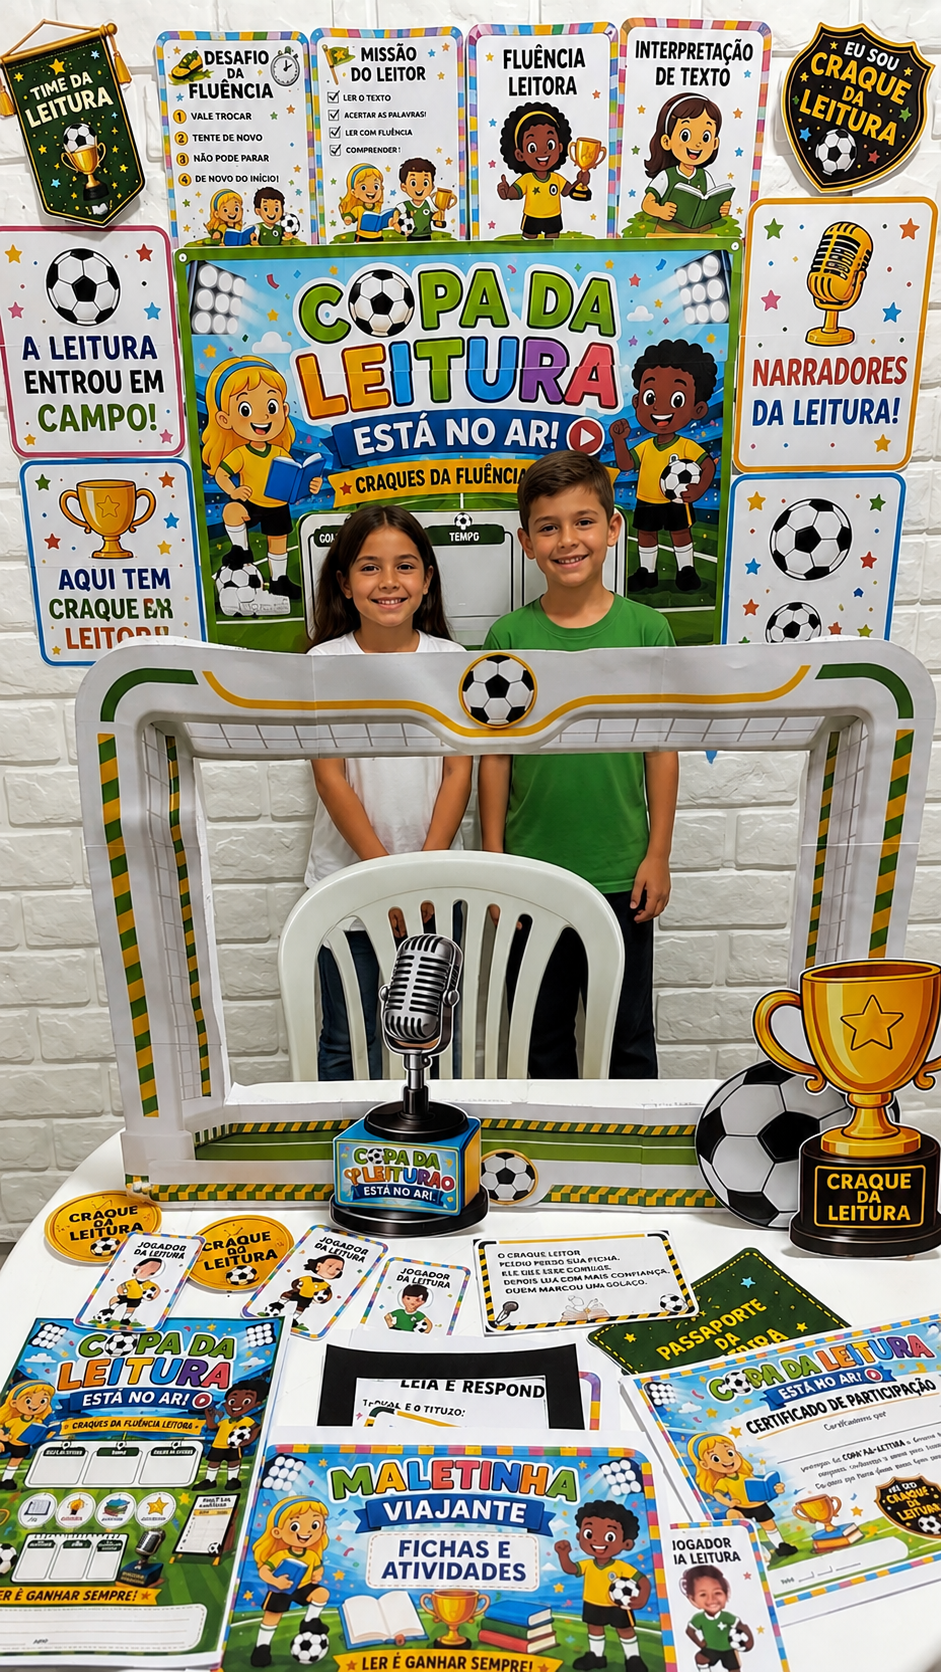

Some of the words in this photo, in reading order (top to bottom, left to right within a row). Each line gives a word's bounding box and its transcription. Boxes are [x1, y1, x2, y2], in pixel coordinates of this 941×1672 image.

[204, 50, 269, 66] DESAFIO
[361, 43, 417, 62] MISSÃO
[503, 44, 586, 70] FLUÊNCIA
[635, 39, 753, 65] INTERPRETAÇÃO
[844, 41, 864, 58] EU
[866, 48, 900, 71] SOU
[227, 68, 244, 79] DA
[351, 67, 372, 82] DO
[377, 65, 426, 82] LEITOR
[656, 67, 675, 86] DE
[680, 67, 731, 87] TEXTO
[810, 52, 913, 105] CRAQUE
[30, 77, 68, 101] TIME
[70, 71, 93, 87] DA
[188, 80, 273, 99] FLUÊNCIA
[508, 75, 578, 96] LEITORA
[842, 86, 864, 106] DA
[25, 86, 114, 128] LEITURA
[343, 94, 357, 102] LER
[358, 94, 365, 102] O
[366, 94, 391, 102] TEXTO
[799, 89, 898, 146] LEITURA
[192, 134, 220, 142] TENTE
[222, 134, 235, 142] DE
[236, 134, 263, 142] NOVO
[193, 152, 213, 162] NÃO
[215, 154, 239, 162] PODE
[240, 154, 269, 162] PARAR
[250, 174, 279, 183] INÍCIO!
[299, 268, 510, 344] COPA
[527, 271, 618, 337] DA
[22, 336, 40, 360] A
[49, 335, 158, 361] LEITURA
[24, 369, 122, 394] ENTROU
[130, 369, 165, 393] EM
[295, 336, 618, 421] LEITURA
[752, 356, 908, 386] NARRADORES
[37, 403, 158, 432] CAMPO!
[752, 399, 784, 426] DA
[793, 398, 900, 425] LEITURA!
[353, 412, 436, 455] ESTÁ
[446, 417, 496, 445] NO
[504, 421, 560, 449] AR!
[355, 468, 425, 494] CRAQUES
[430, 468, 451, 485] DA
[59, 568, 115, 592] AQUI
[122, 568, 171, 590] TEM
[49, 598, 139, 622] CRAQUE
[354, 1148, 410, 1166] COPA
[413, 1151, 440, 1170] DA
[364, 1184, 391, 1196] ESTÁ
[393, 1186, 410, 1196] NO
[827, 1173, 912, 1191] CRAQUE
[857, 1190, 881, 1203] DA
[828, 1205, 911, 1221] LEITURA
[69, 1222, 143, 1241] LEITURA
[202, 1231, 271, 1252] CRAQUE
[314, 1243, 328, 1254] DA
[328, 1246, 366, 1263] LEITURA
[319, 1236, 369, 1256] JOGADOR
[204, 1249, 278, 1270] LEITURA
[396, 1274, 410, 1283] DA
[412, 1277, 451, 1289] LEITURA
[400, 1267, 450, 1281] JOGADOR
[656, 1298, 767, 1361] PASSAPORTE
[77, 1331, 183, 1358] COPA
[188, 1334, 235, 1360] DA
[714, 1332, 741, 1350] DA
[780, 1356, 822, 1380] DA
[816, 1334, 935, 1371] LEITURA
[56, 1357, 231, 1391] LEITURA
[82, 1387, 124, 1406] ESTÁ
[128, 1392, 155, 1404] NO
[158, 1392, 189, 1406] AR!
[400, 1380, 439, 1390] LEIA
[445, 1380, 456, 1392] E
[463, 1381, 545, 1398] RESPOND
[778, 1384, 812, 1400] ESTÁ
[746, 1401, 827, 1434] CERTIFICADO
[830, 1397, 847, 1410] DE
[846, 1378, 936, 1408] PARTICIPAÇÃO
[72, 1420, 108, 1429] CRAQUES
[331, 1461, 577, 1500] MALETINHA
[382, 1499, 527, 1523] VIAJANTE
[398, 1539, 489, 1558] FICHAS
[499, 1540, 510, 1558] E
[690, 1551, 741, 1564] LEITURA
[381, 1560, 526, 1582] ATIVIDADES
[26, 1590, 79, 1601] GANHAR
[83, 1590, 138, 1601] SEMPRE!
[362, 1656, 388, 1670] LER
[392, 1652, 402, 1669] É
[405, 1656, 467, 1670] GANHAR
[471, 1656, 534, 1672] SEMPRE!
